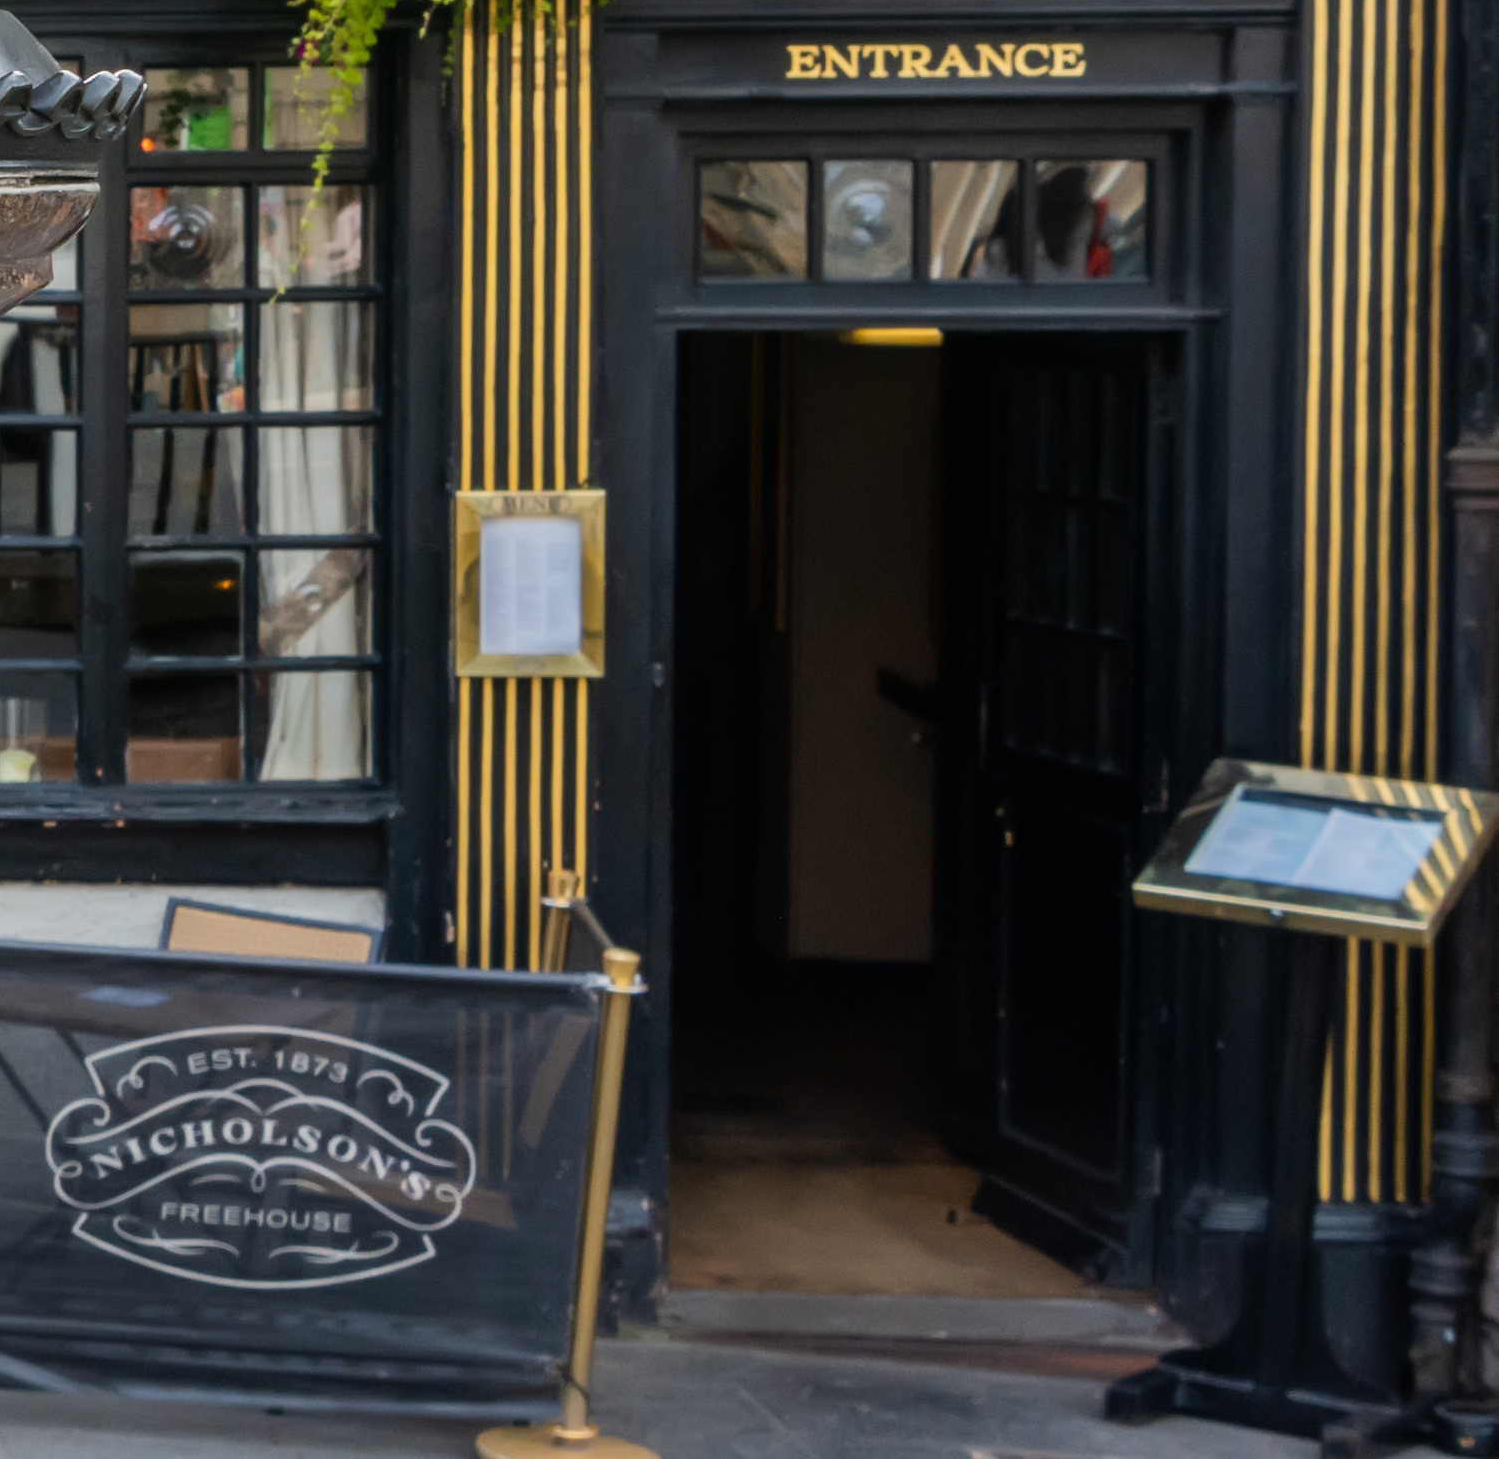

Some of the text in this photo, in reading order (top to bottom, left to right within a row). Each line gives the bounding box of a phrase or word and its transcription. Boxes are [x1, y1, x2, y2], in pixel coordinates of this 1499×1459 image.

[784, 42, 1086, 80] ENTRANCE
[274, 1050, 349, 1084] 1873
[88, 1117, 433, 1201] NICHOLSON'S
[159, 1201, 353, 1234] FREEHOUSE
